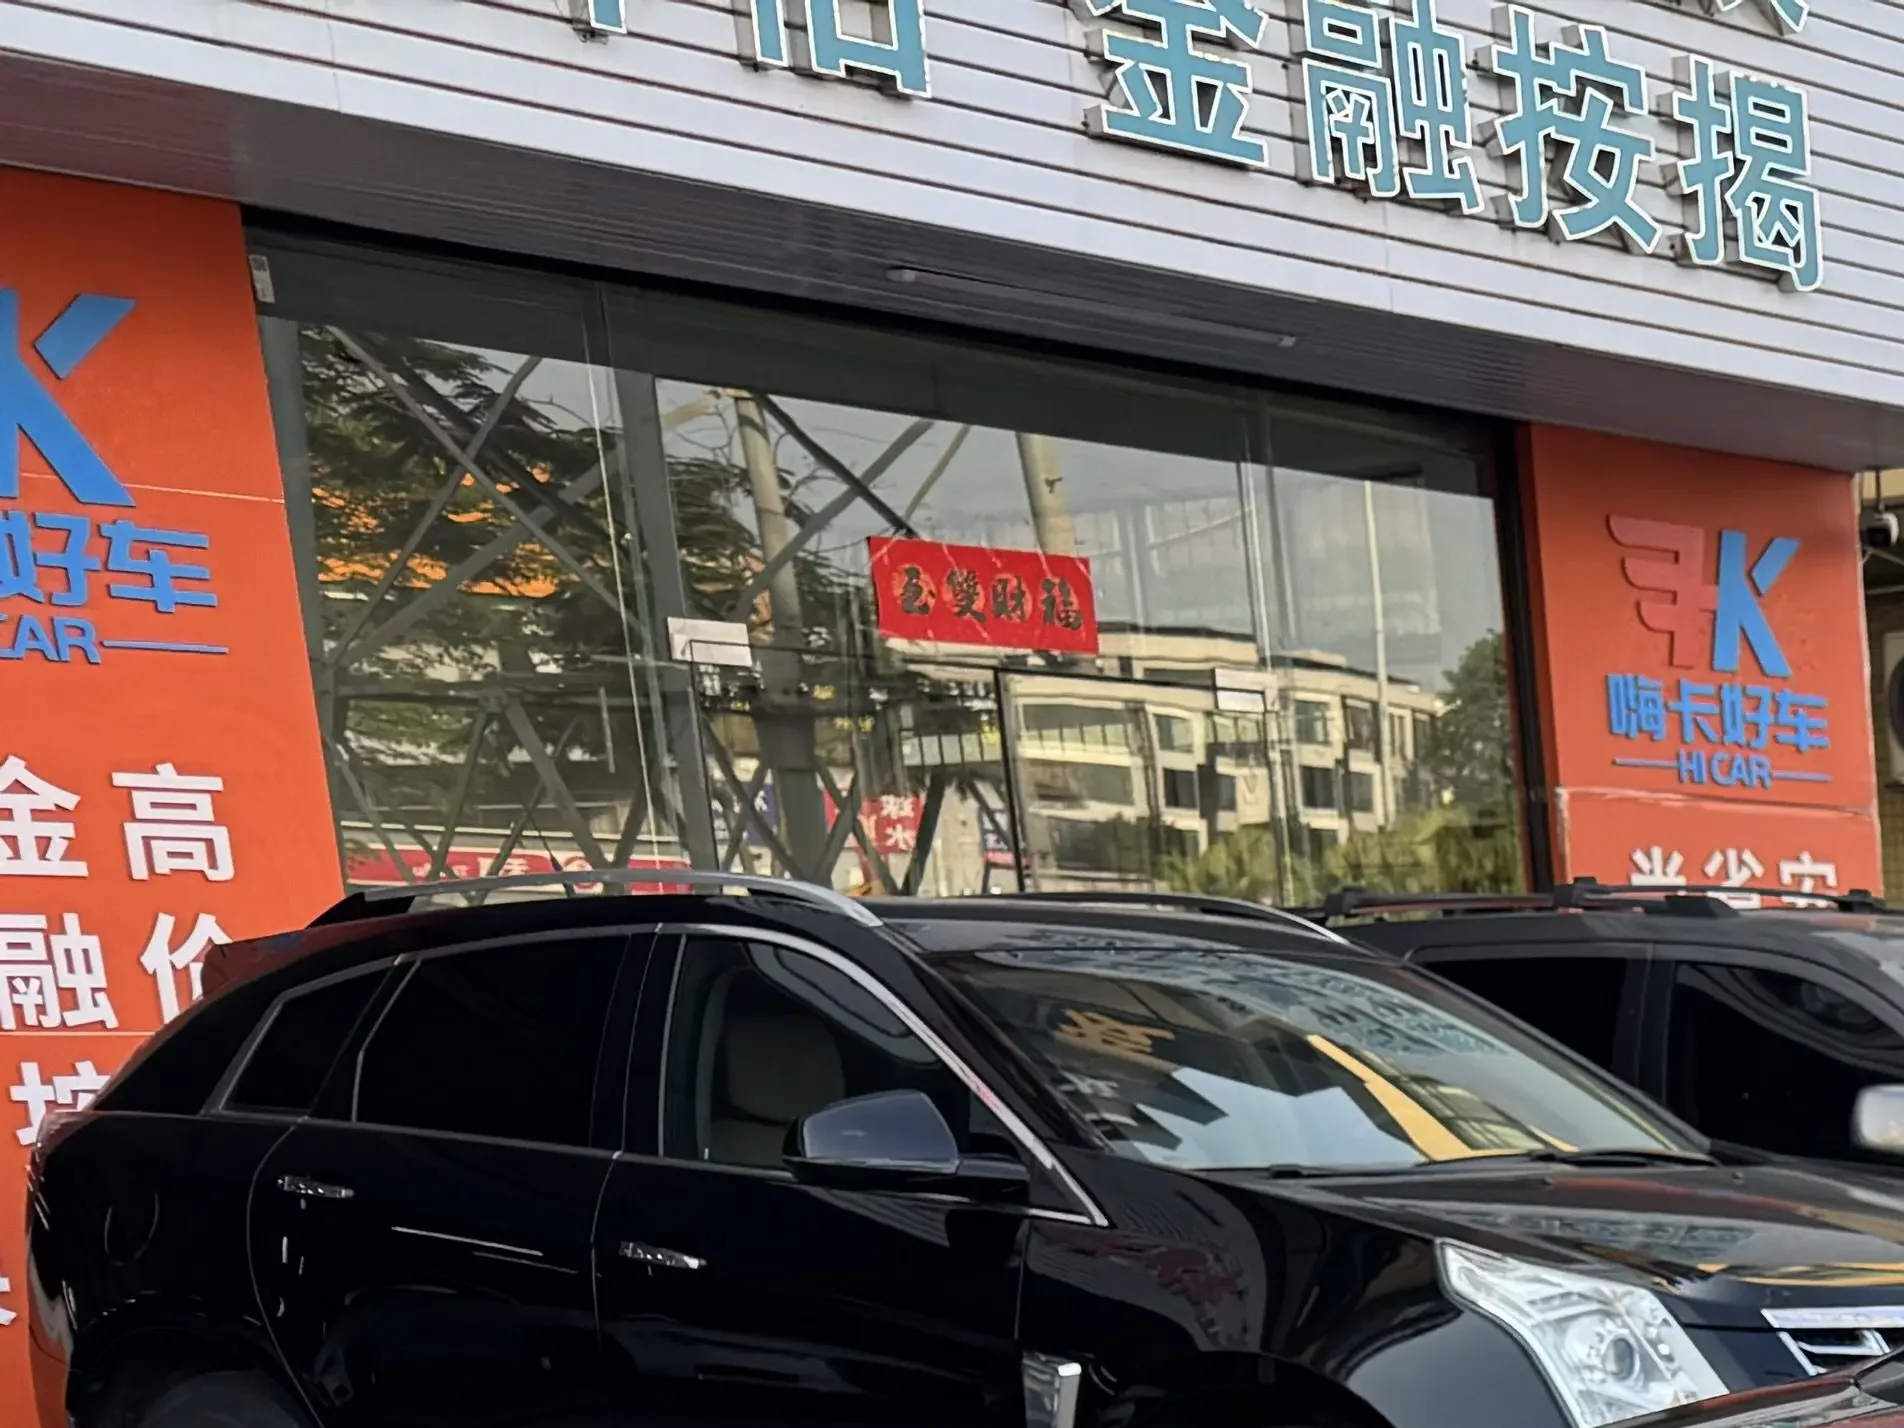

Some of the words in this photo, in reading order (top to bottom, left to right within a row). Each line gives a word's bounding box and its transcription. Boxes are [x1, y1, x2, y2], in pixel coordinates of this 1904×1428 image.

[1086, 0, 1823, 291] 金融按揭
[1606, 672, 1831, 753] 嗨卡好车
[1710, 753, 1773, 790] CAR
